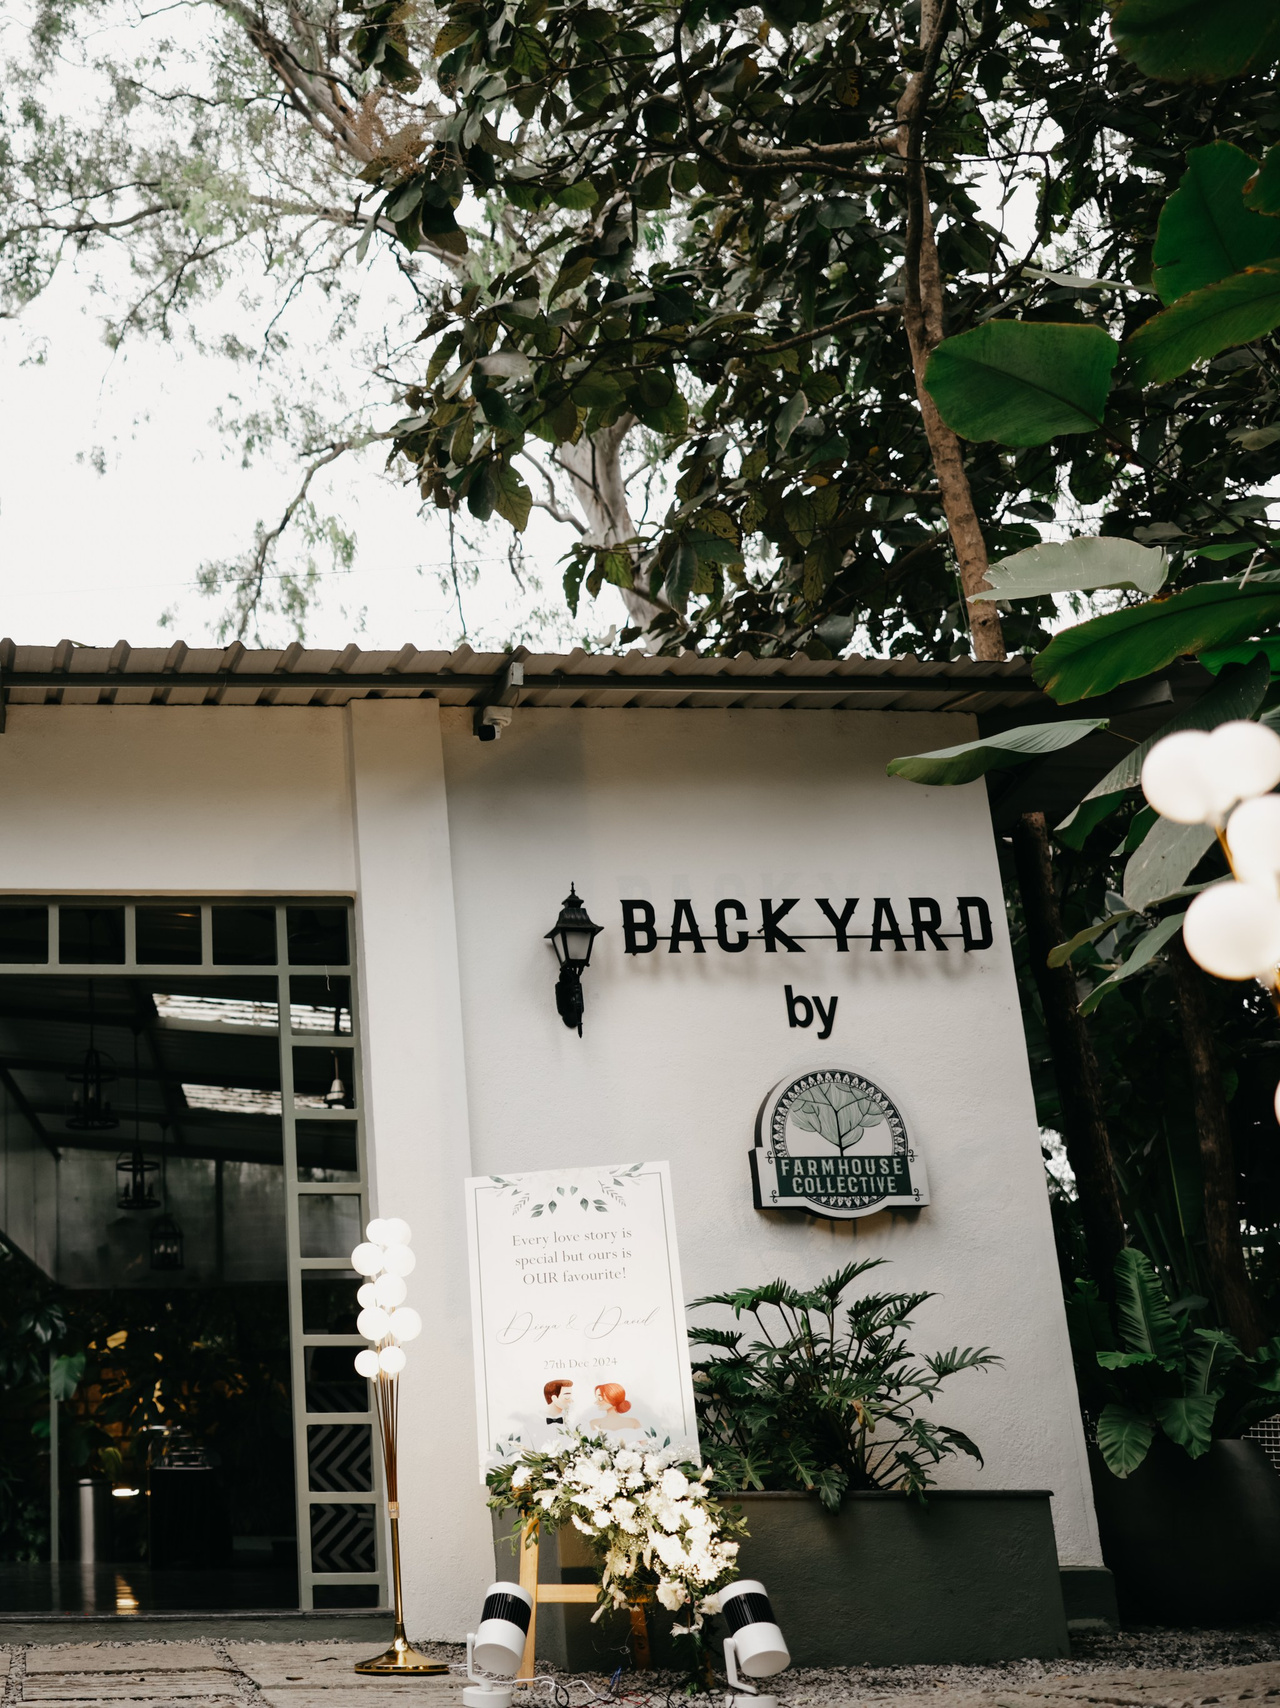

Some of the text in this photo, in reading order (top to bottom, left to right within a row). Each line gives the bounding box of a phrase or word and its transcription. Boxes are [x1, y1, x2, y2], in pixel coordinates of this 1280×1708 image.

[620, 896, 993, 955] BACKYARD
[784, 984, 838, 1039] by
[780, 1158, 904, 1176] FARMHOUSE
[792, 1176, 897, 1193] COLLECTIVE
[512, 1227, 632, 1249] Every love story is
[515, 1247, 632, 1270] special but ours is
[523, 1267, 626, 1285] OUR favourite!
[584, 1306, 660, 1340] David
[543, 1357, 618, 1370] 27th Dec 2024
